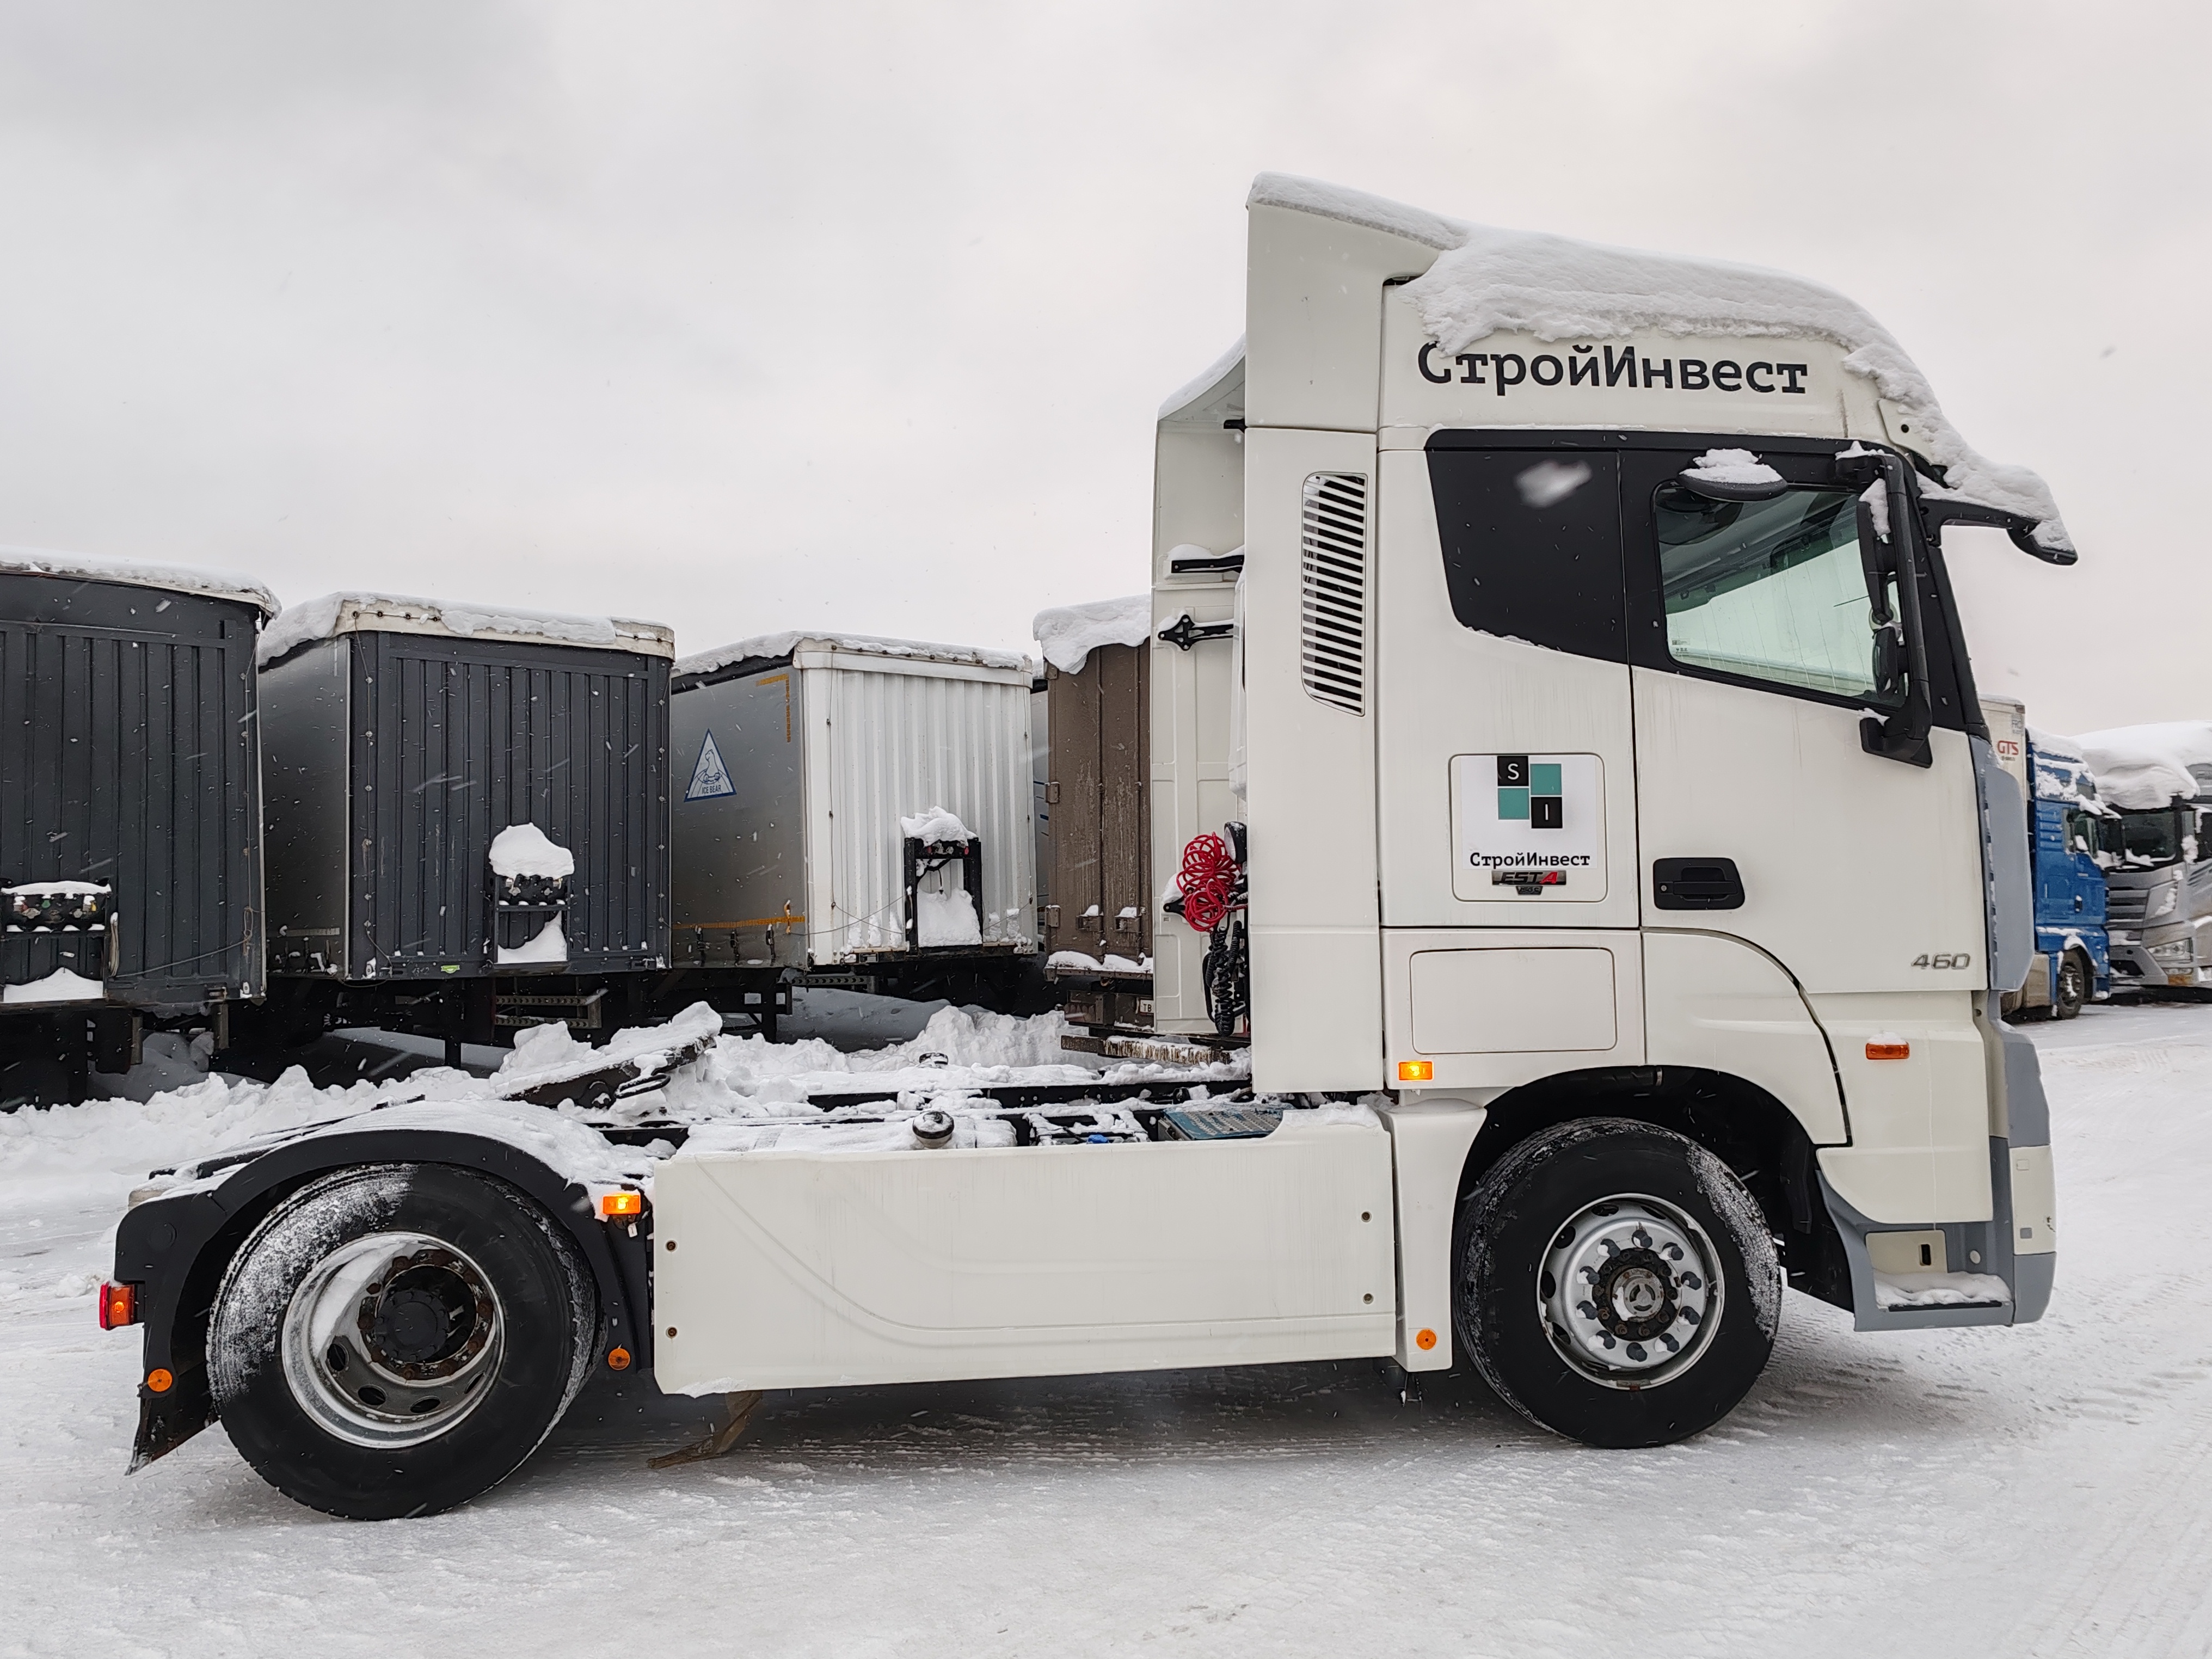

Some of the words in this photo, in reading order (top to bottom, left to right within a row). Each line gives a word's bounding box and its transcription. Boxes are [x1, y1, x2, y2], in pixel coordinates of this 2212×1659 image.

[1417, 341, 1808, 396] СтройИнвест
[1997, 740, 2019, 755] GTS
[1507, 763, 1520, 780] S
[710, 784, 722, 793] BEAR
[1545, 804, 1549, 820] I
[1470, 852, 1590, 869] СтройИнвест
[1911, 953, 1971, 969] 460
